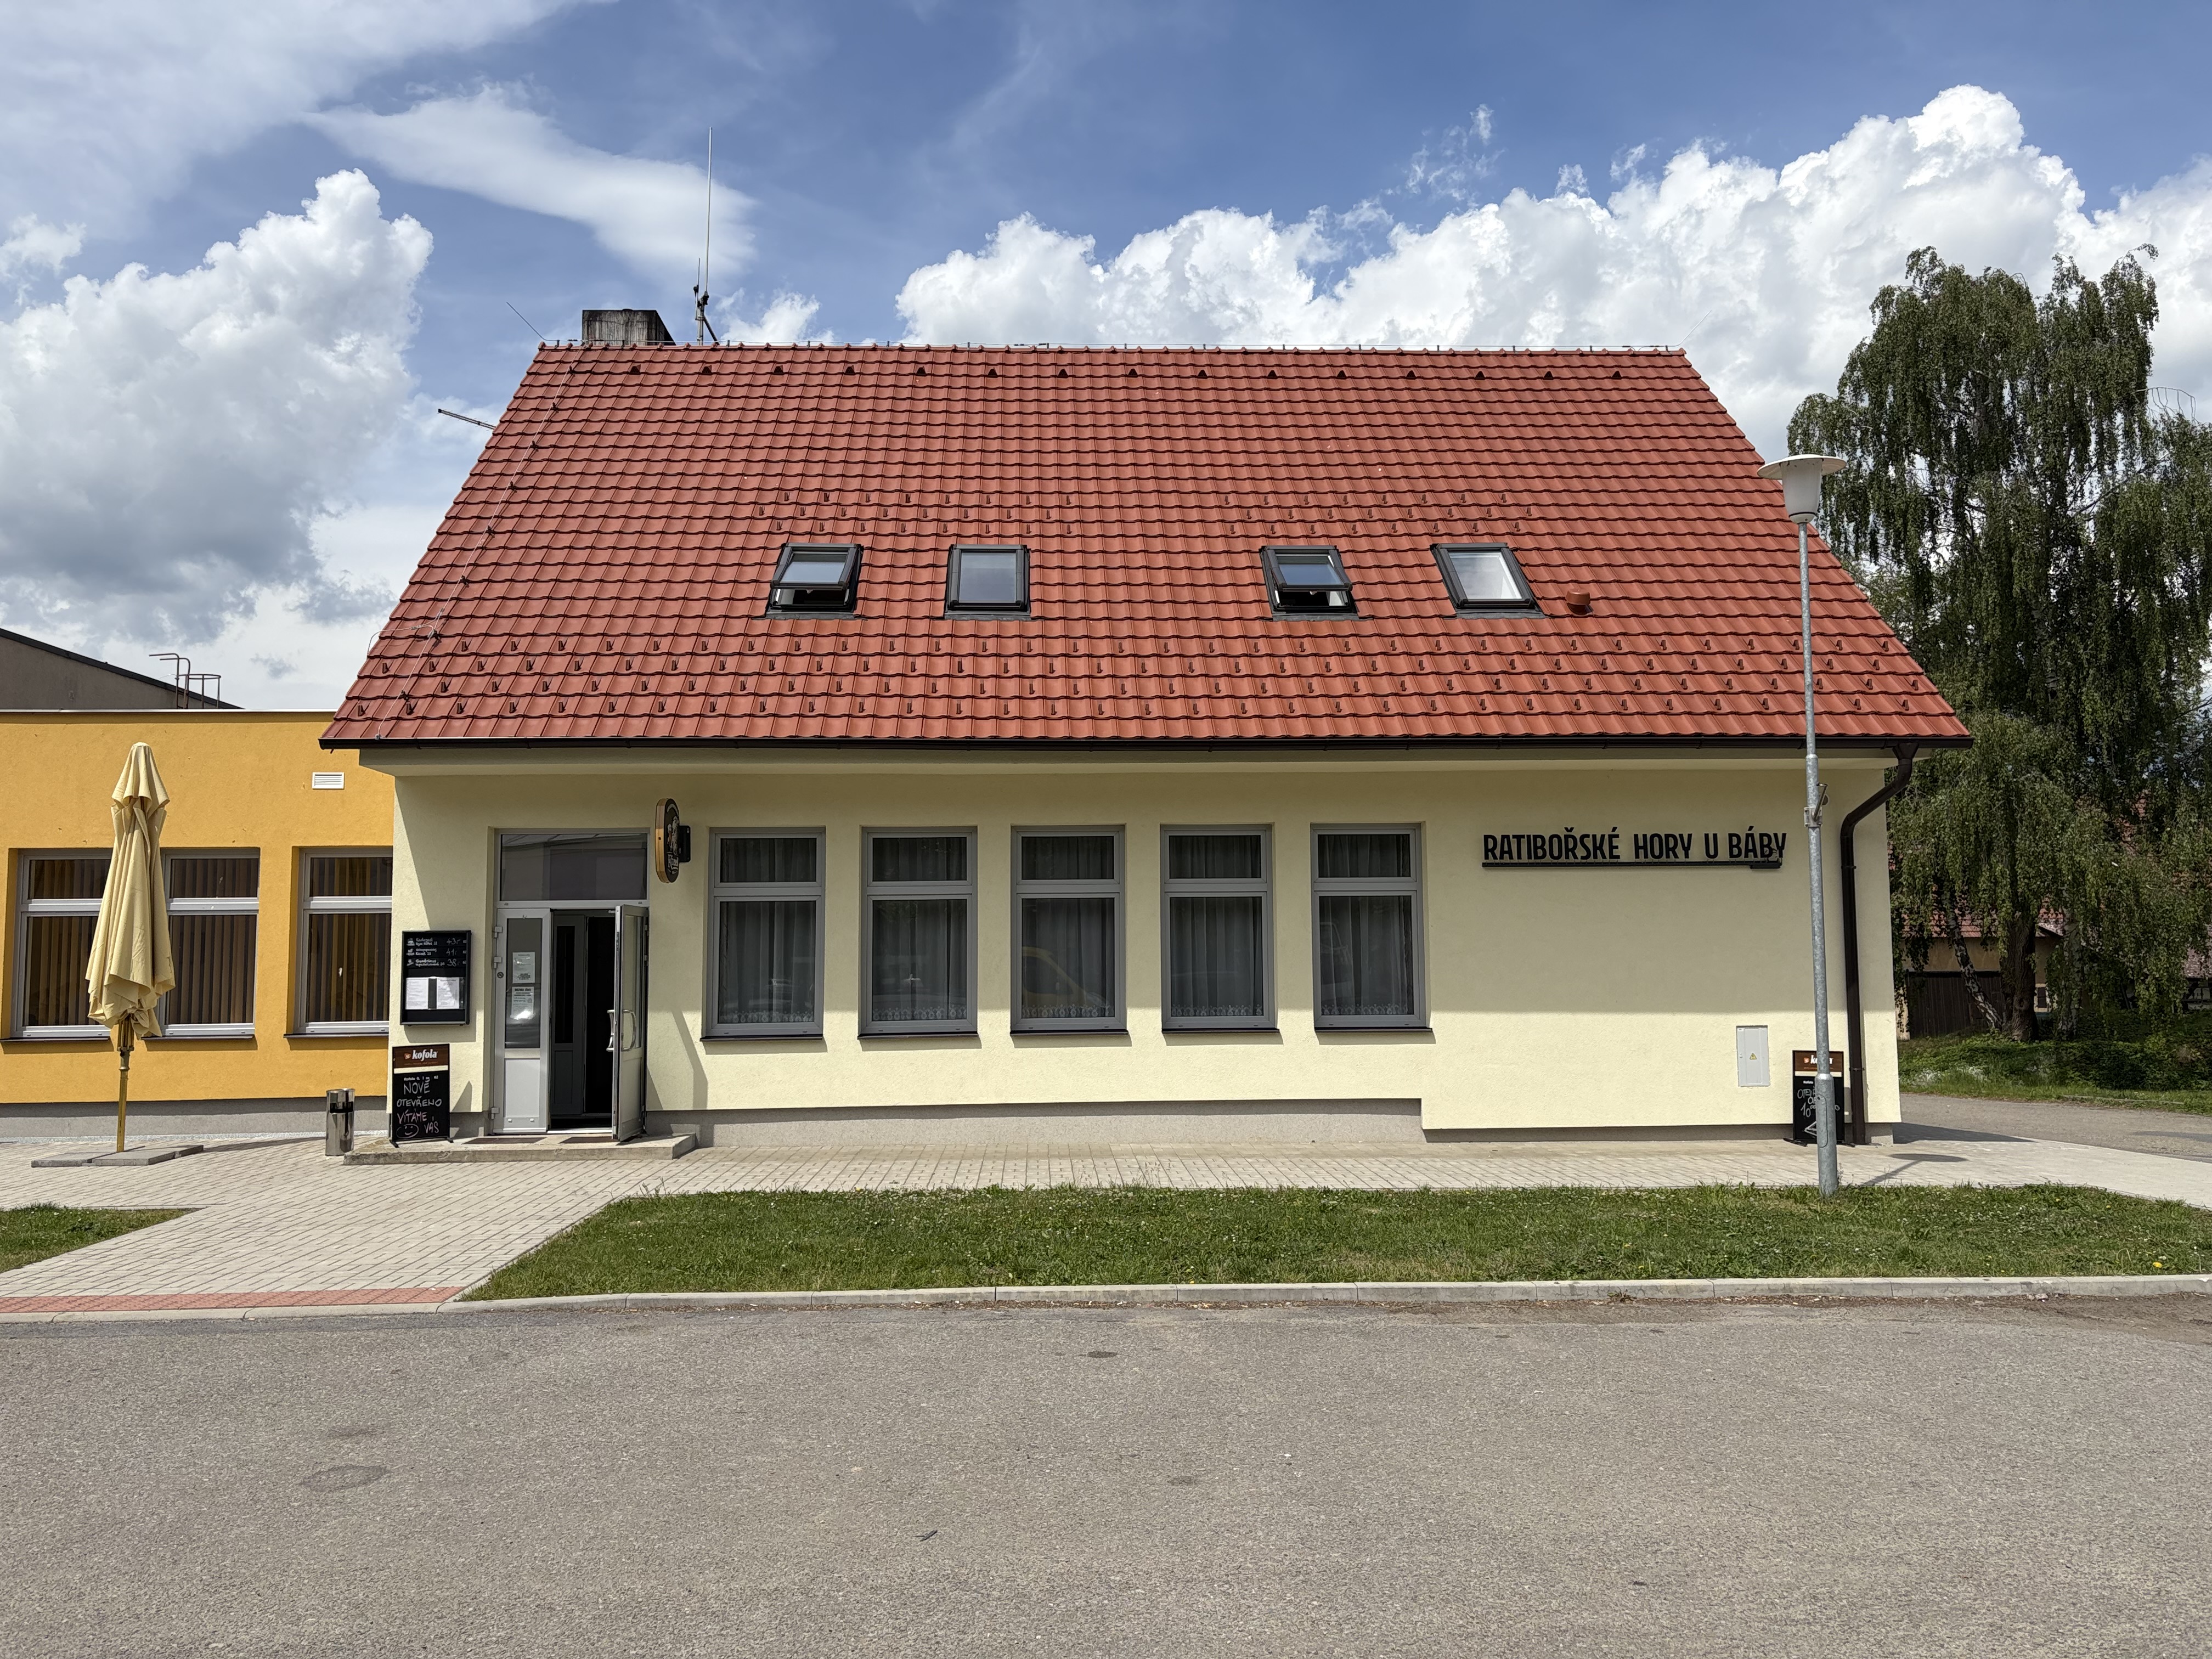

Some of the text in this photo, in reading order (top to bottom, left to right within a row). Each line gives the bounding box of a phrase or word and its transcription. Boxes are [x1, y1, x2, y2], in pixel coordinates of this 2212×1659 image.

[1483, 826, 1787, 860] RATIBOŘSKÉ HORY U BÁBY
[412, 1049, 437, 1062] kofola
[397, 1096, 442, 1107] OTEVŘENO
[397, 1108, 427, 1124] VÍTÁME
[424, 1116, 439, 1133] VÁS
